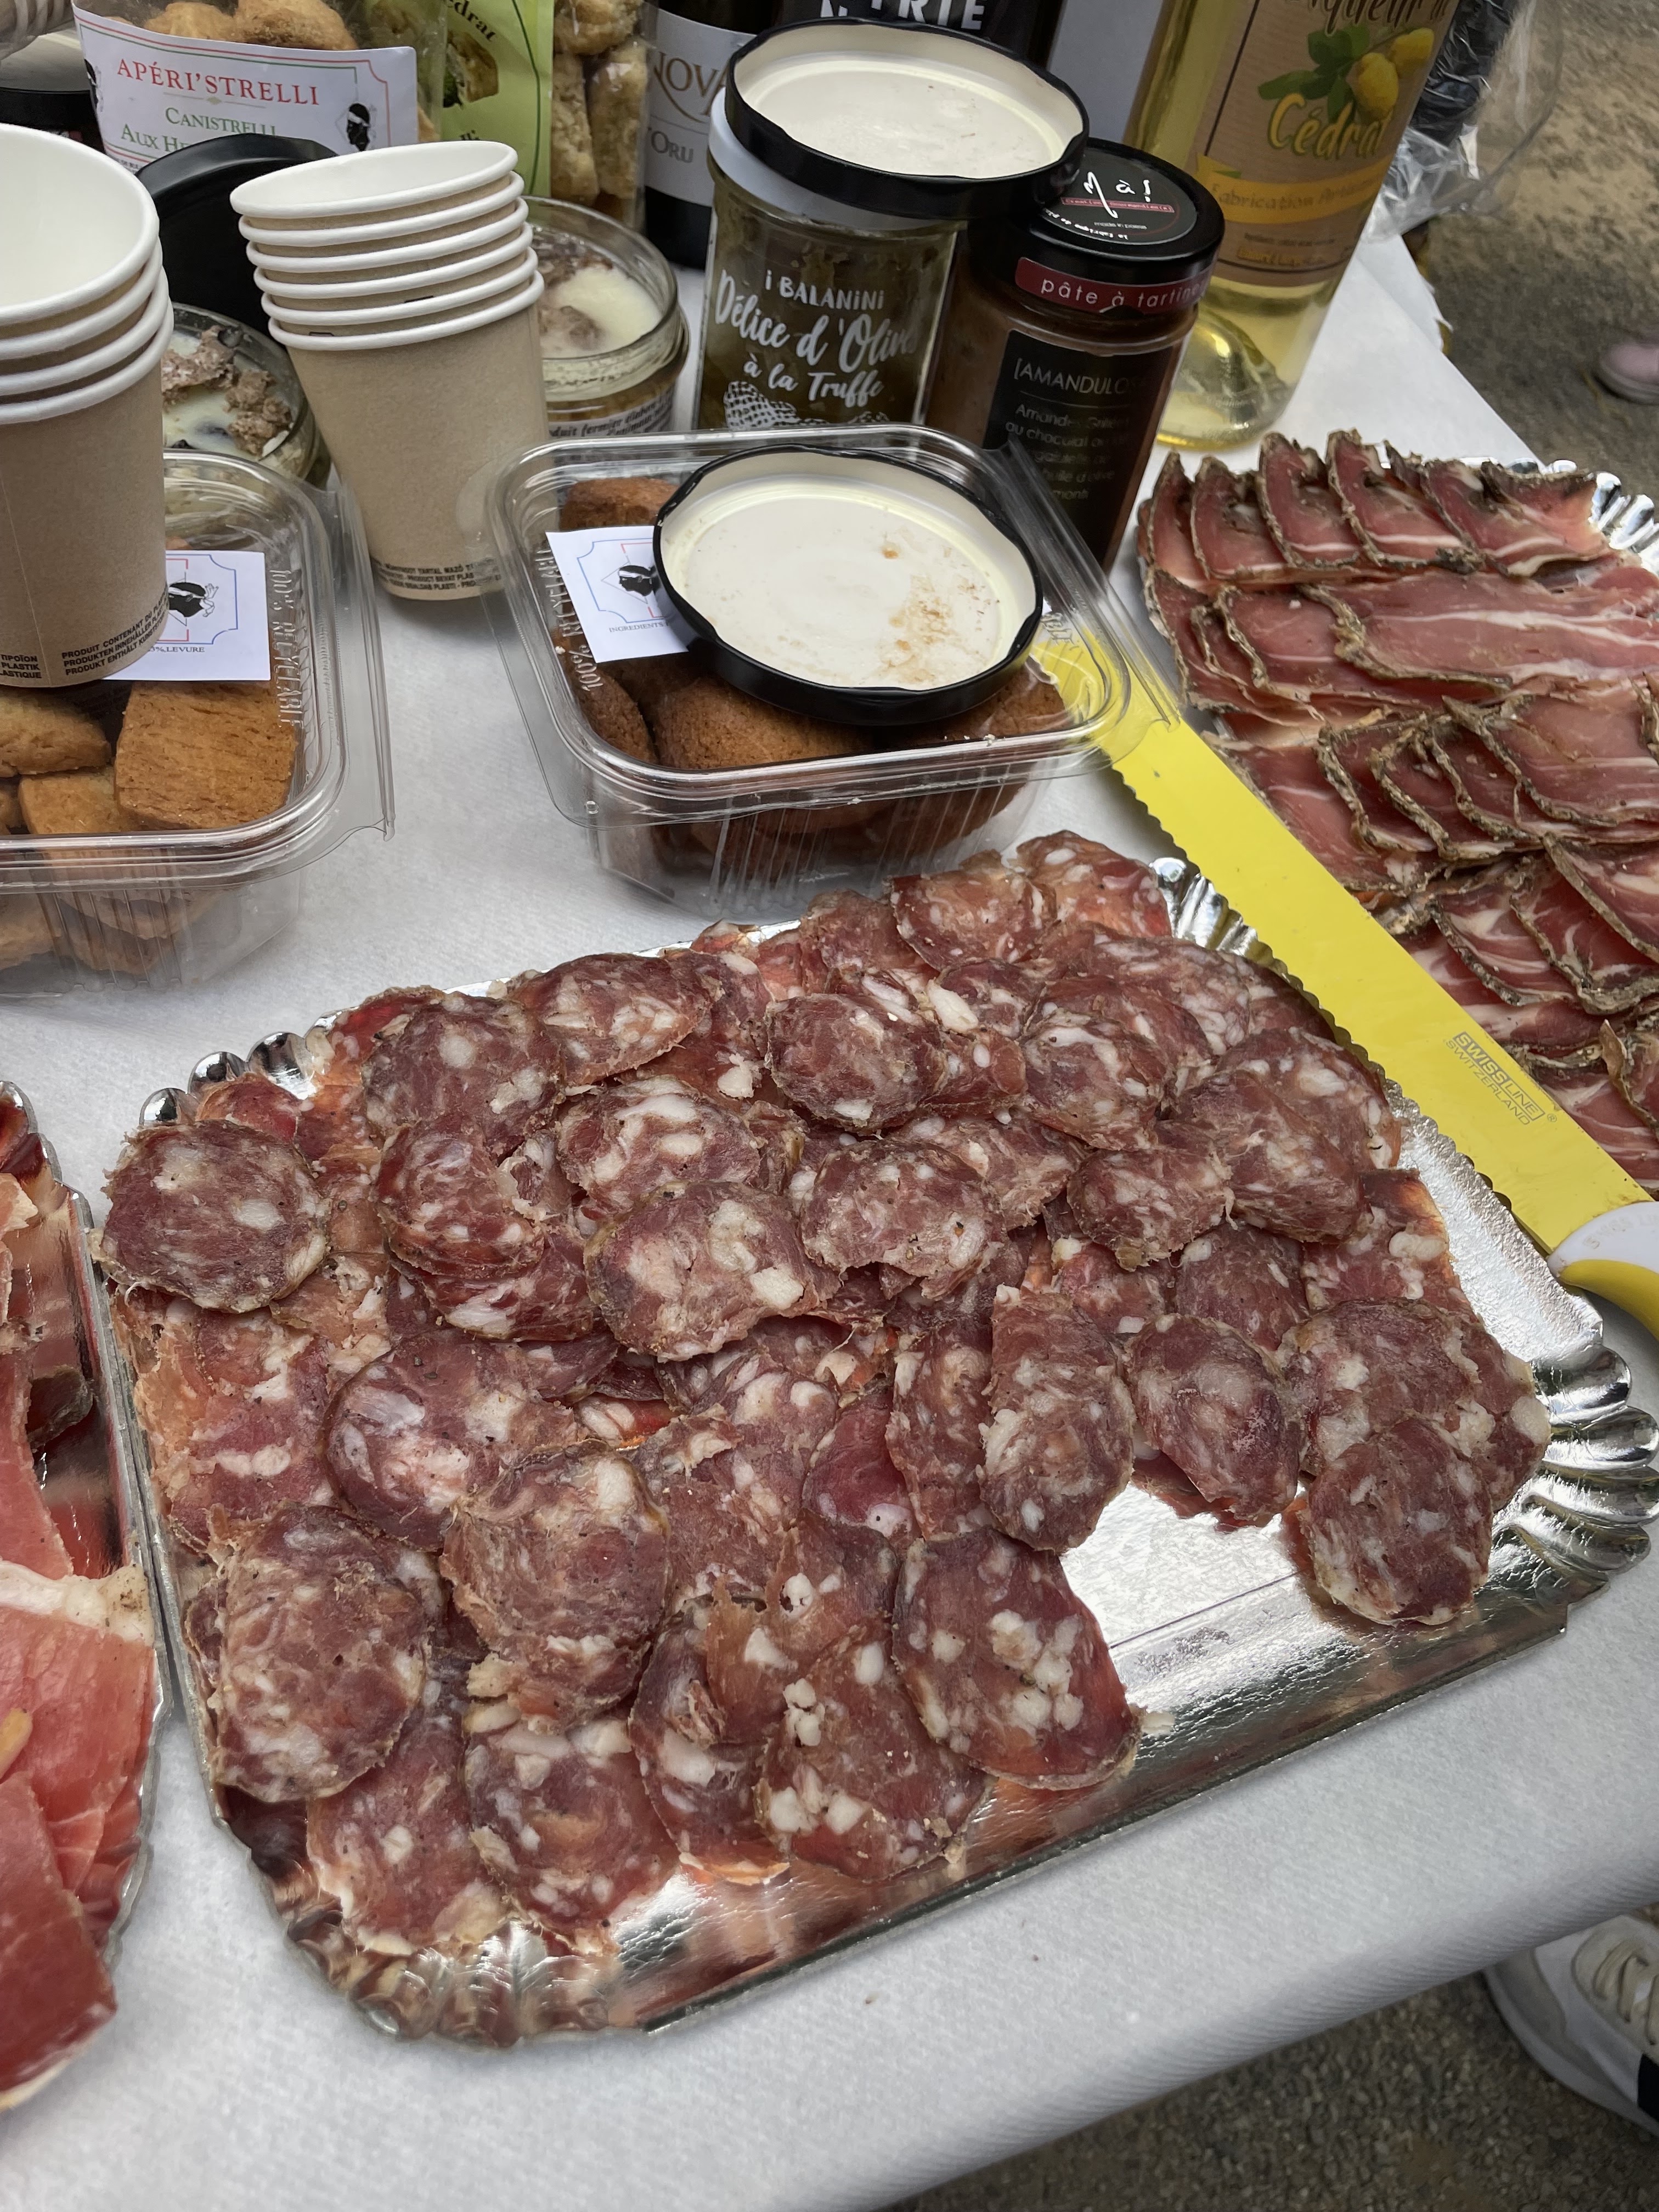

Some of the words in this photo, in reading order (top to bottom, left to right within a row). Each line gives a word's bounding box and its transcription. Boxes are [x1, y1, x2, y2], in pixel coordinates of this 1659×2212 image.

[117, 58, 319, 105] APÉRI'STRELLI
[121, 123, 159, 150] AUX
[715, 269, 791, 348] Délice
[1040, 278, 1098, 304] pâte
[1111, 291, 1125, 307] à
[743, 352, 762, 378] à
[769, 363, 799, 392] la
[808, 370, 883, 408] Truffe
[1005, 421, 1024, 436] au
[62, 644, 100, 659] PRODUIT
[103, 618, 144, 648] CONTENANT
[144, 609, 153, 622] DU
[64, 648, 114, 667] PRODUKTEN
[115, 620, 152, 651] INNEHÅLLER
[1, 662, 41, 670] PLASTIK
[65, 660, 105, 675] PRODUKT
[108, 641, 138, 663] ENTHÄLT
[272, 620, 304, 729] RECYCLABLE
[1446, 1041, 1531, 1125] SWITZERLAND
